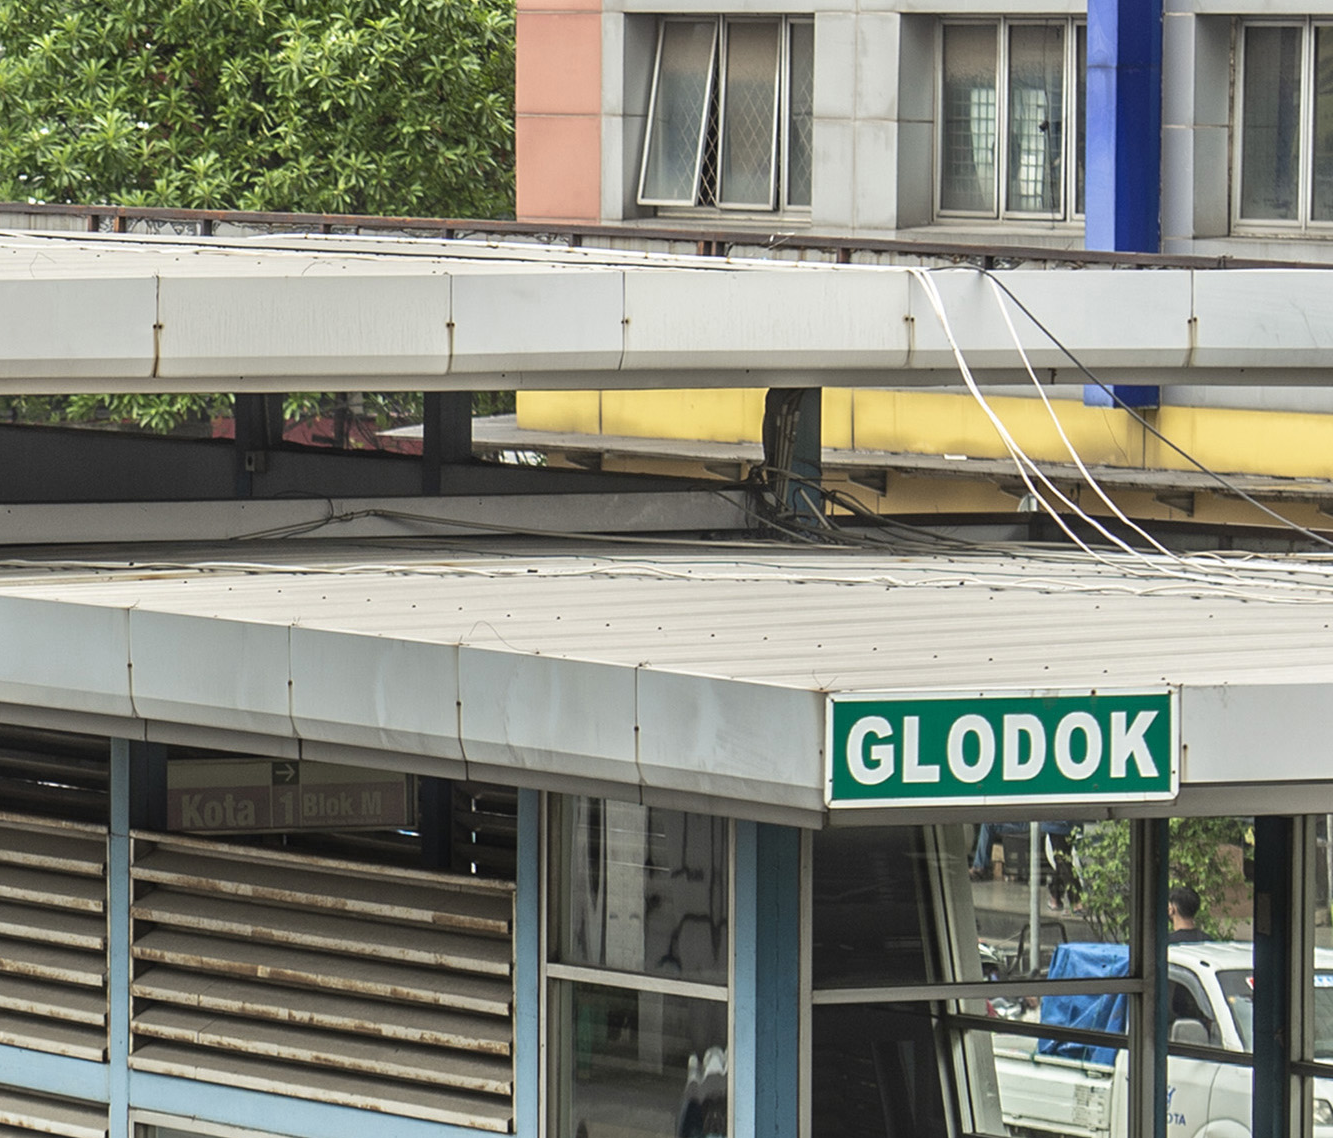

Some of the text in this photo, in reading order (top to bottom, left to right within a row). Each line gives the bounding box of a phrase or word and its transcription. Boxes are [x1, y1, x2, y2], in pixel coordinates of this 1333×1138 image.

[846, 711, 1159, 785] GLODOK
[181, 794, 255, 828] Kota
[279, 792, 295, 825] 1
[303, 791, 382, 817] Blok M
